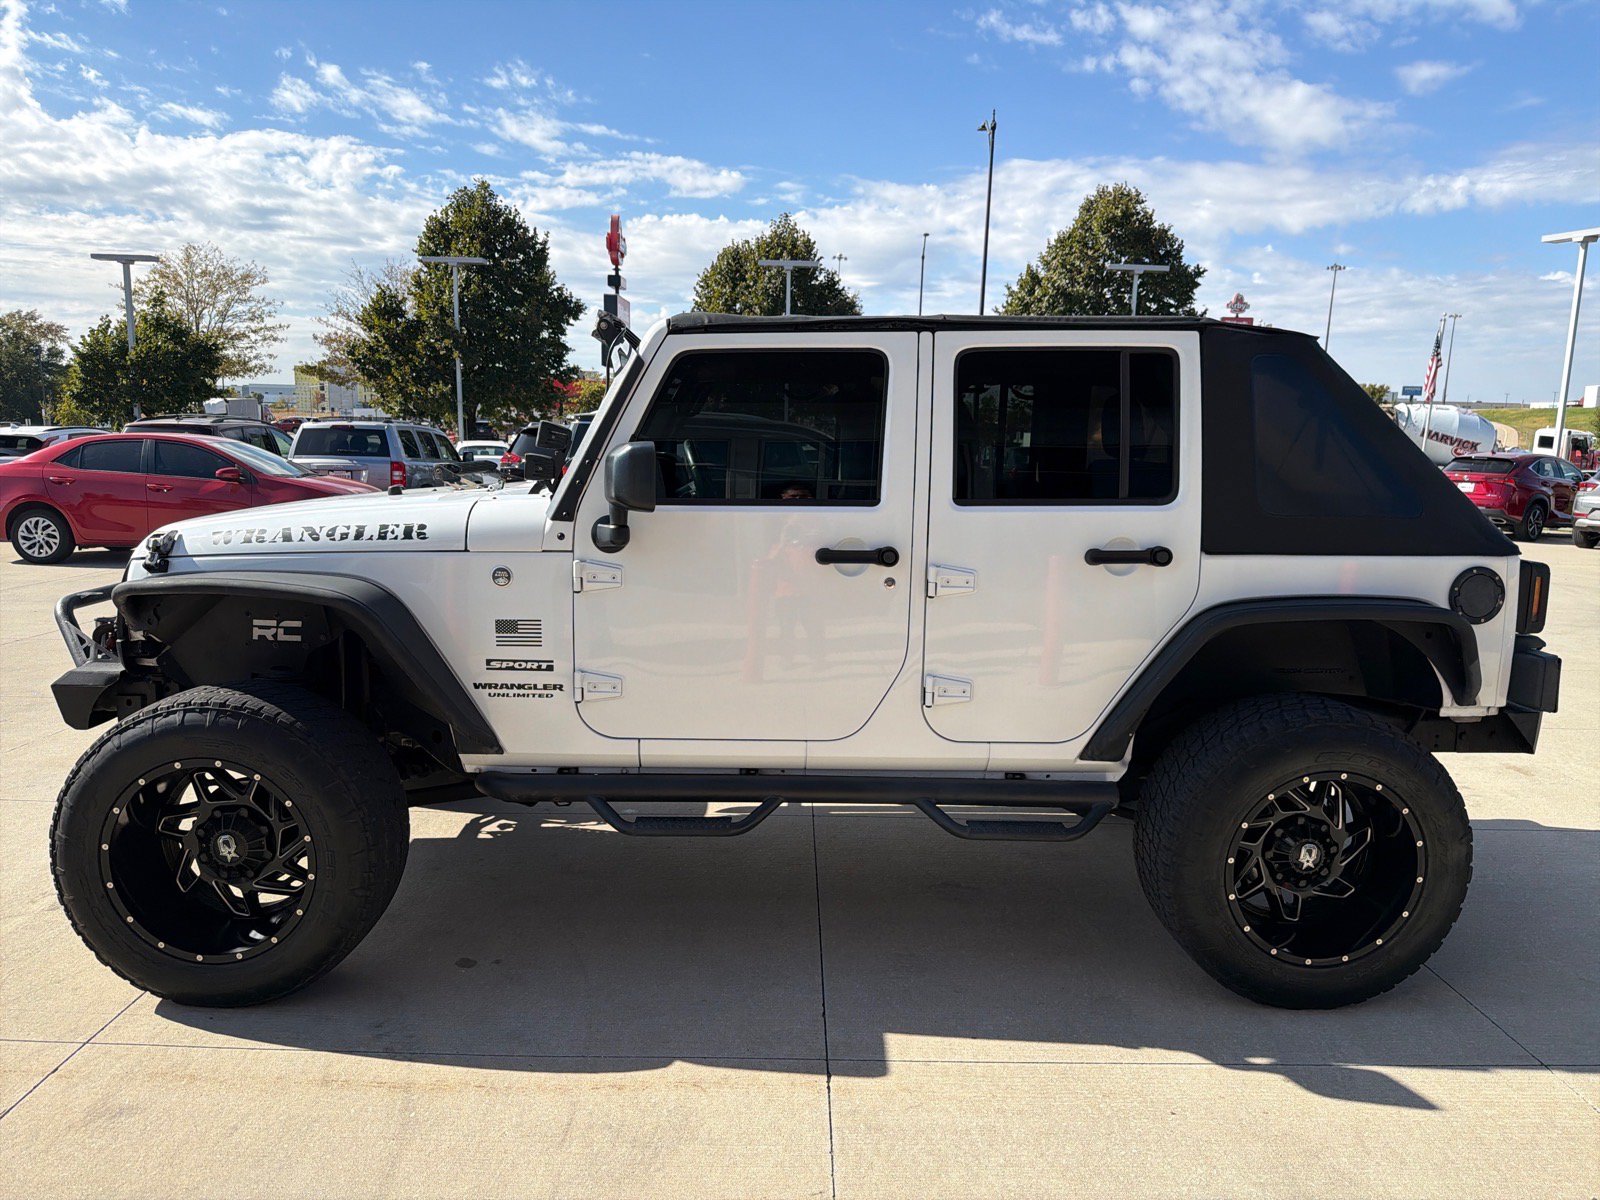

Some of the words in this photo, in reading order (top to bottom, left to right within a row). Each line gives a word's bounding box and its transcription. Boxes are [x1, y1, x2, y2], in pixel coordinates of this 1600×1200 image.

[1420, 428, 1481, 451] HARVICK
[211, 523, 430, 545] WRANGLER
[252, 619, 303, 642] RC
[489, 660, 552, 670] SPORT
[473, 682, 564, 691] WRANGLER
